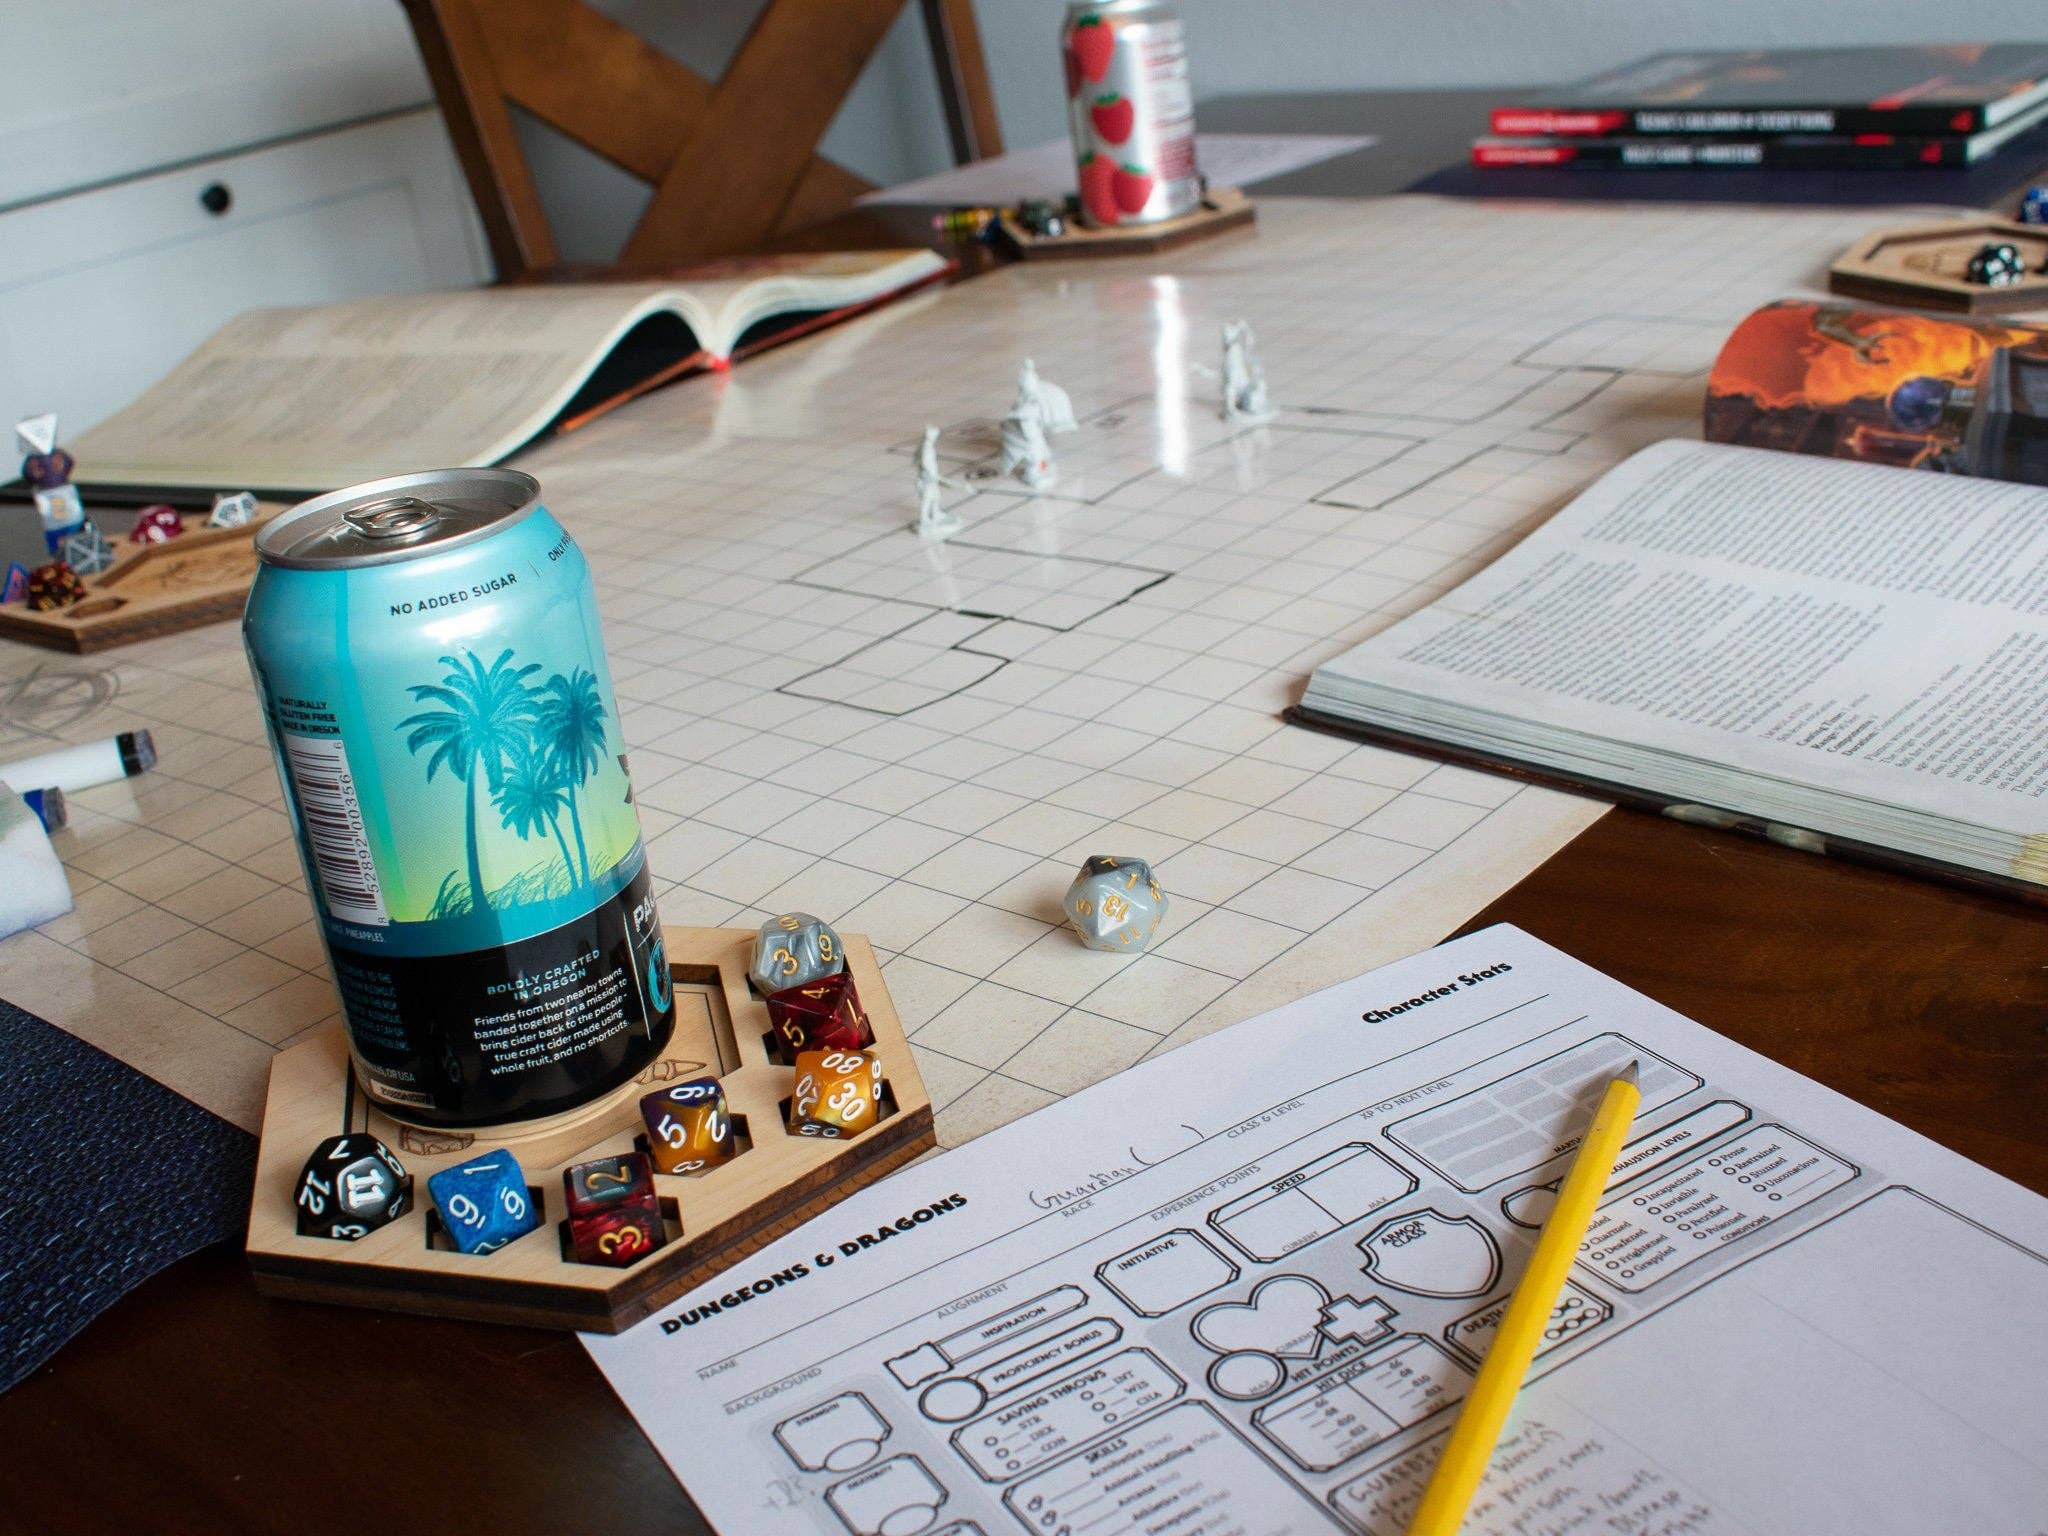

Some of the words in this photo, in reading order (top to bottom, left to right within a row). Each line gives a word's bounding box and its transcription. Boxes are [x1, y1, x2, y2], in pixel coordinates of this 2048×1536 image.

[390, 603, 413, 616] NO
[417, 590, 469, 612] ADDED
[472, 573, 518, 598] SUGAR
[280, 697, 328, 710] NATURALLY
[312, 712, 337, 722] FREE
[339, 774, 364, 831] 00356
[354, 838, 380, 893] 52892
[487, 975, 540, 996] BOLDLY
[544, 949, 600, 980] CRAFTED
[773, 948, 798, 975] 3
[474, 1011, 516, 1027] Friends
[517, 1004, 545, 1018] from
[545, 995, 566, 1009] two
[566, 983, 598, 1004] nearby
[598, 967, 623, 987] towns
[513, 990, 529, 1001] IN
[533, 968, 588, 996] OREGON
[801, 987, 831, 1000] 4
[1361, 981, 1461, 1024] Character
[1457, 962, 1513, 987] Stats
[474, 1022, 518, 1040] banded
[518, 1011, 565, 1032] together
[565, 1007, 578, 1017] on
[579, 1003, 586, 1011] a
[586, 987, 619, 1007] mission
[619, 978, 628, 989] to
[480, 1039, 510, 1053] bring
[510, 1033, 537, 1047] cider
[539, 1023, 565, 1039] back
[565, 1019, 577, 1030] to
[577, 1011, 593, 1024] the
[594, 996, 623, 1018] people
[490, 1062, 525, 1077] whole
[526, 1054, 552, 1068] fruit,
[553, 1048, 573, 1062] and
[574, 1043, 587, 1053] no
[587, 1019, 630, 1047] shortcuts.
[494, 1051, 518, 1063] true
[519, 1044, 546, 1058] craft
[547, 1036, 572, 1050] cider
[573, 1023, 600, 1040] made
[601, 1008, 624, 1028] using
[782, 1017, 806, 1048] 5
[821, 1052, 864, 1074] 80
[828, 1081, 866, 1122] 30
[1360, 1109, 1375, 1120] XP
[1376, 1102, 1394, 1114] TO
[1396, 1091, 1422, 1107] NEXT
[1423, 1079, 1454, 1096] LEVEL
[658, 1114, 688, 1149] 5
[801, 1123, 841, 1138] 50
[1227, 1119, 1261, 1140] CLASS
[1262, 1112, 1271, 1123] &
[1272, 1099, 1305, 1119] LEVEL
[1610, 1144, 1662, 1176] XHAUSTION
[1660, 1130, 1693, 1151] LEVELS
[1719, 1145, 1748, 1163] Prone
[1734, 1143, 1782, 1172] Restrained
[1749, 1157, 1788, 1179] Stunned
[462, 1163, 500, 1175] 1
[585, 1164, 632, 1190] 2
[1271, 1173, 1307, 1194] SPEED
[1764, 1156, 1820, 1189] Unconscious
[299, 1169, 331, 1216] 12
[346, 1168, 386, 1209] 11
[1151, 1185, 1217, 1222] EXPERIENCE
[1218, 1164, 1262, 1190] POINTS
[1645, 1168, 1705, 1202] Incapacitated
[1659, 1187, 1700, 1211] Invisible
[1061, 1199, 1096, 1220] RACE
[1674, 1193, 1720, 1221] Paralyzed
[1689, 1204, 1730, 1228] Petrified
[331, 1223, 368, 1239] 3
[1282, 1230, 1321, 1253] CURRENT
[1367, 1195, 1388, 1210] MAX
[1380, 1219, 1424, 1246] ARMOR
[1391, 1228, 1427, 1249] CLASS
[1589, 1220, 1633, 1247] Charmed
[1705, 1211, 1748, 1237] Poisoned
[1720, 1214, 1771, 1242] CONDITIONS
[598, 1224, 643, 1256] 3
[1117, 1239, 1178, 1271] INITIATIVE
[1602, 1228, 1648, 1255] Deafened
[1617, 1233, 1669, 1265] Frightened
[660, 1261, 811, 1336] DUNGEONS
[813, 1246, 836, 1269] &
[837, 1192, 970, 1258] DRAGONS
[1633, 1245, 1677, 1273] Grappled
[936, 1281, 1010, 1321] ALIGNMENT
[981, 1305, 1047, 1339] INSPIRATION
[1463, 1306, 1503, 1334] DEATH
[699, 1358, 738, 1381] NAME
[993, 1347, 1063, 1384] PROFICIENCY
[1063, 1329, 1102, 1351] BONUS
[1290, 1364, 1314, 1384] HIT
[1313, 1343, 1361, 1371] POINTS
[724, 1367, 823, 1416] BACKGROUND
[1113, 1369, 1135, 1385] INT
[1124, 1379, 1150, 1395] WIS
[1315, 1377, 1337, 1393] HIT
[1337, 1359, 1371, 1382] DICE
[997, 1396, 1049, 1425] SAVING
[1050, 1369, 1107, 1401] THROWS
[1017, 1414, 1043, 1431] STR
[1029, 1423, 1057, 1442] DEX
[1040, 1434, 1068, 1453] CON
[1084, 1437, 1129, 1464] SKILLS
